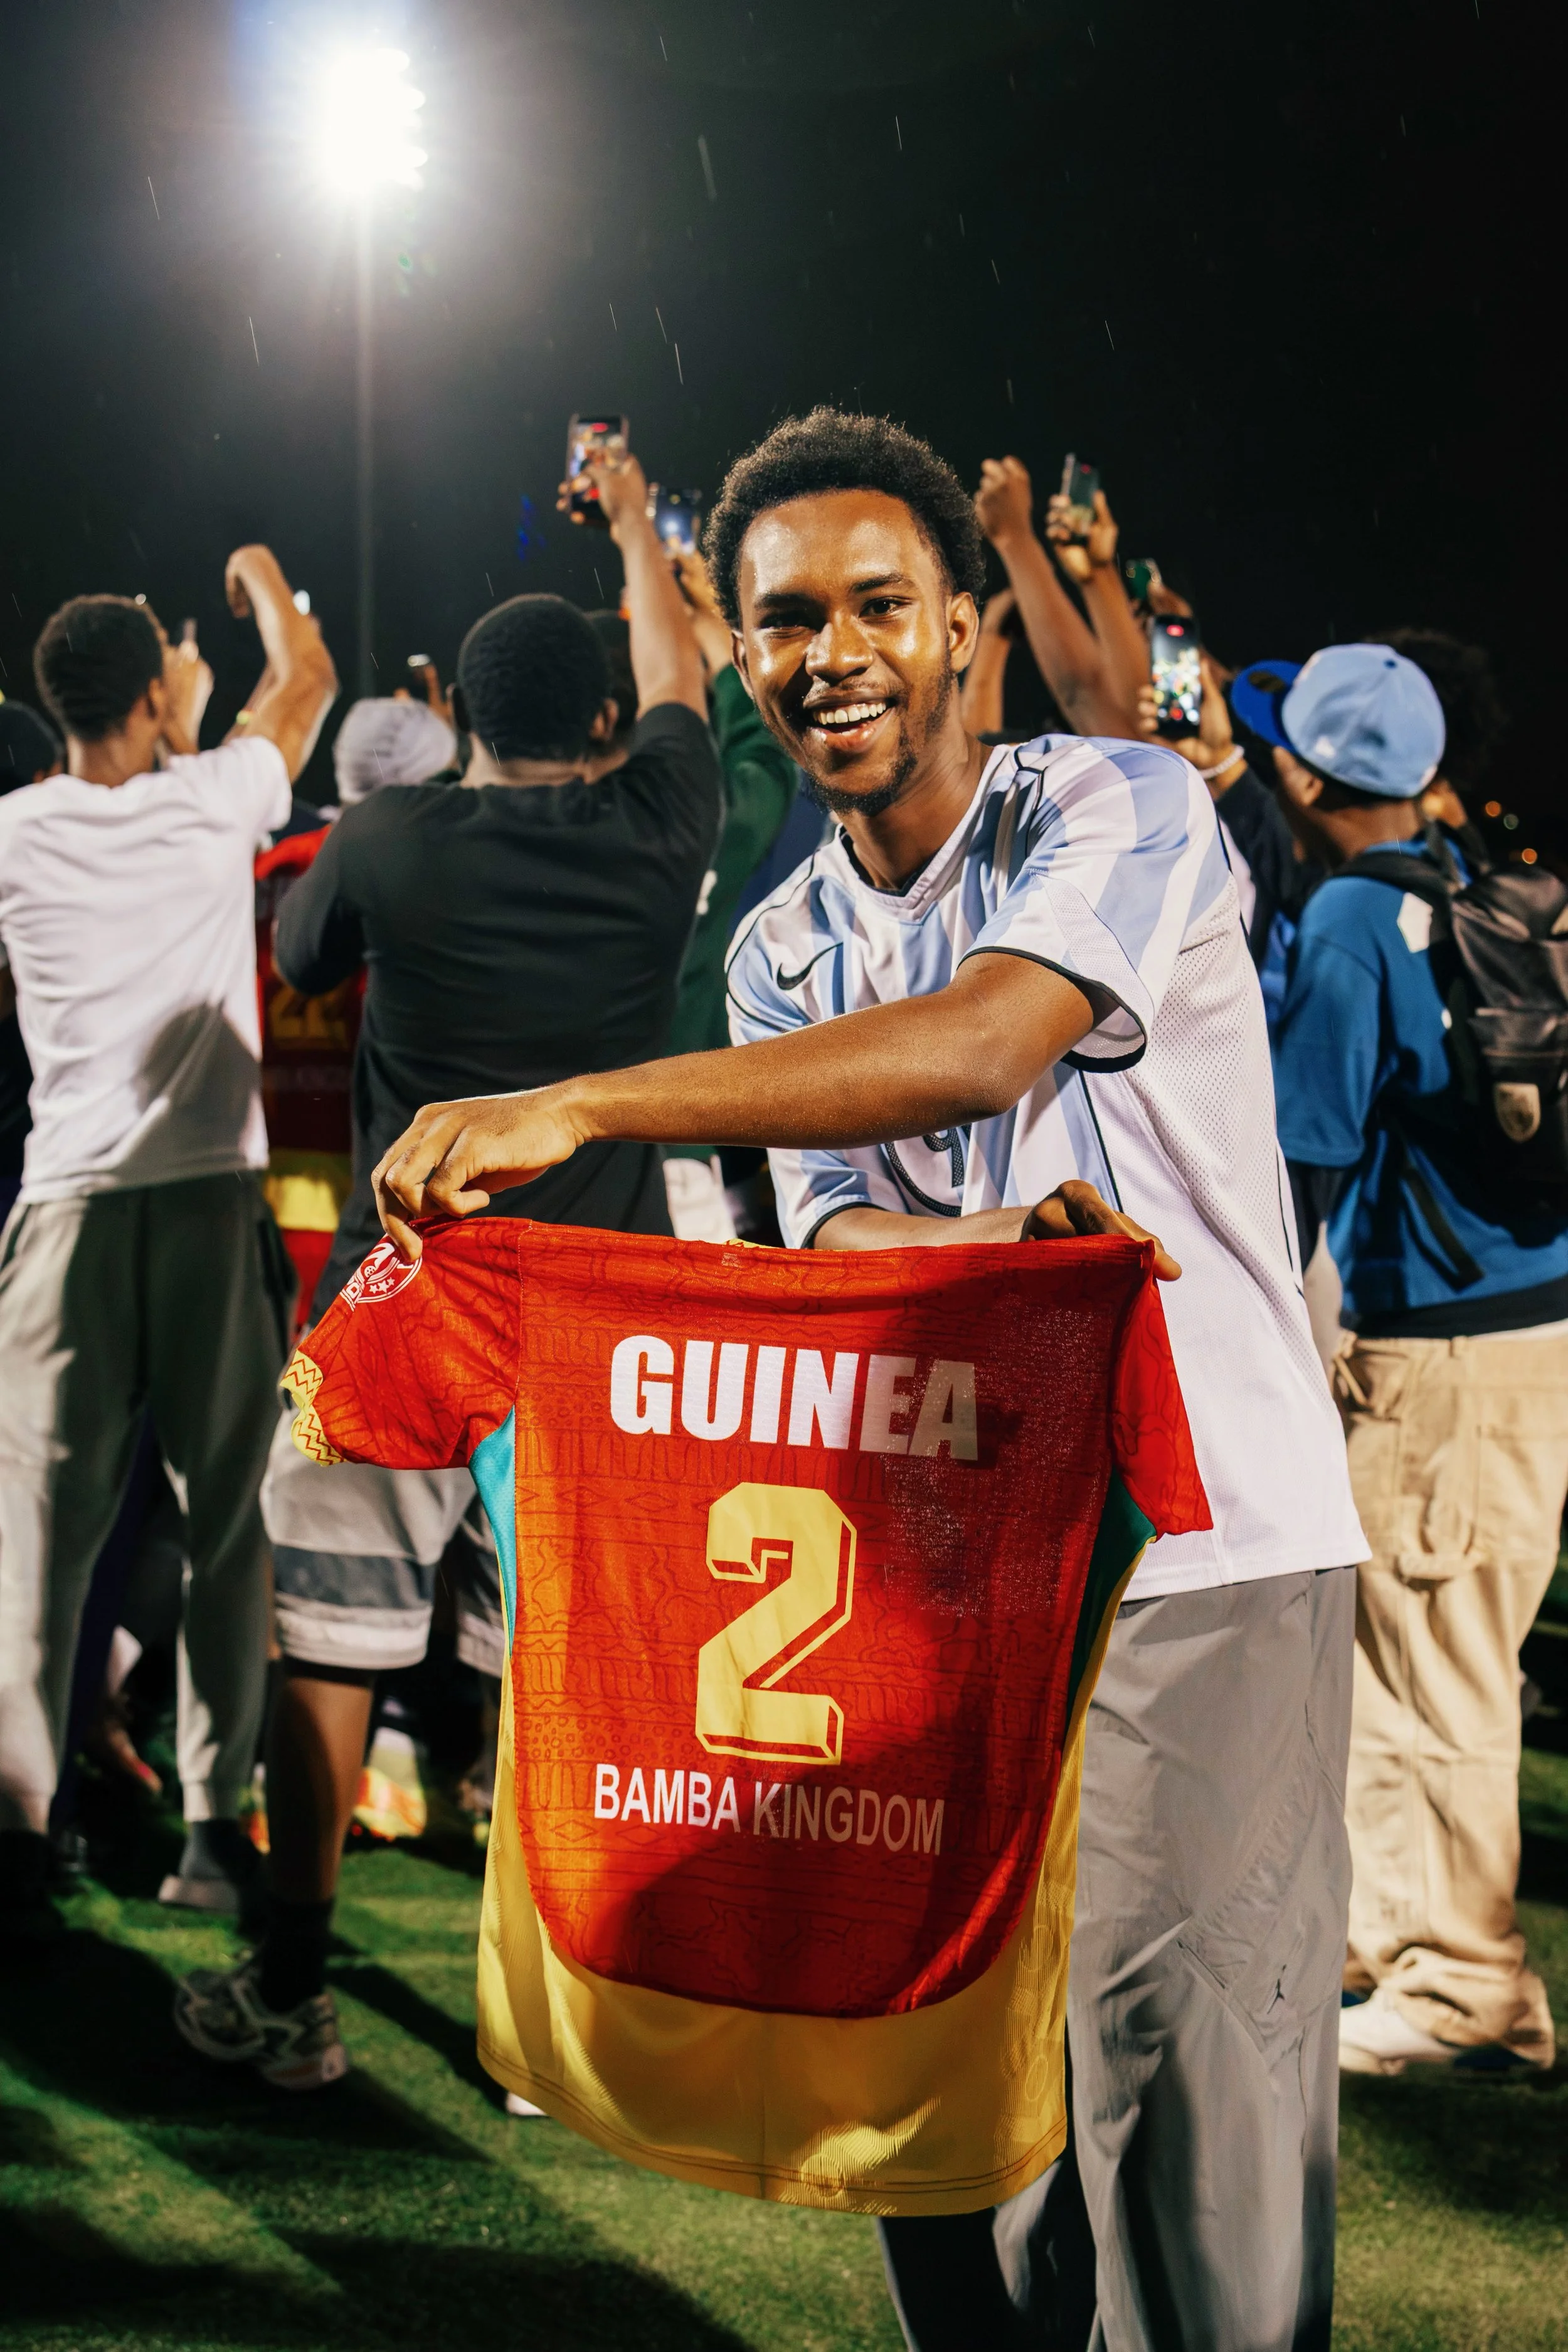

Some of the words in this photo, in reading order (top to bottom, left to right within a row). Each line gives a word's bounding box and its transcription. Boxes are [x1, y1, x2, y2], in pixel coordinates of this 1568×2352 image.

[610, 1335, 978, 1461] GUINEA
[695, 1481, 857, 1766] 2
[594, 1763, 741, 1833] BAMBA
[753, 1781, 945, 1857] KINGDOM
